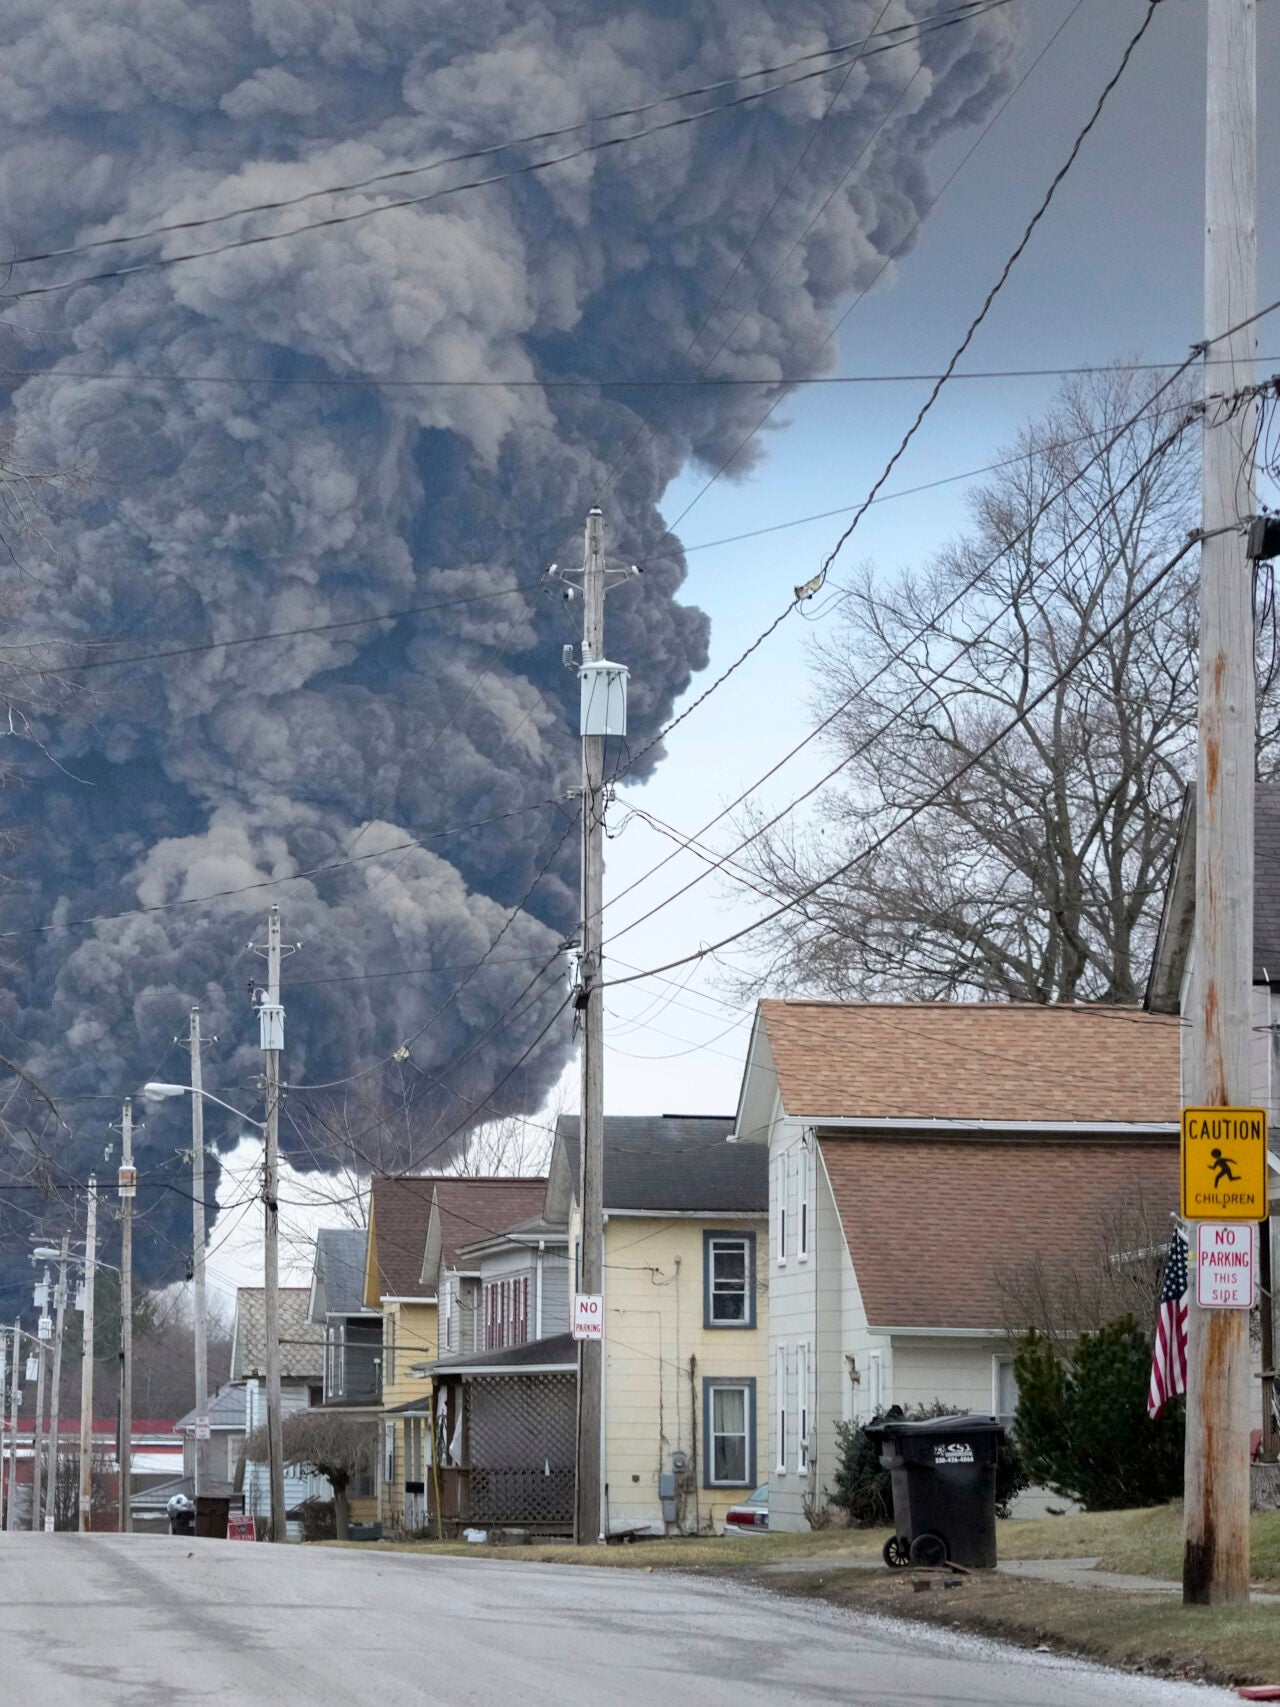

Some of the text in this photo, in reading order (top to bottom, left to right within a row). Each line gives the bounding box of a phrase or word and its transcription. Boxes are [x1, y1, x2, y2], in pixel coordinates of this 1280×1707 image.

[1189, 1119, 1261, 1140] CAUTION
[1195, 1192, 1255, 1205] CHILDREN
[1215, 1230, 1236, 1245] NO
[1201, 1251, 1249, 1268] PARKING
[1213, 1273, 1238, 1284] THIS
[1212, 1289, 1238, 1301] SIDE
[580, 1301, 598, 1314] NO
[576, 1323, 601, 1333] PARKING
